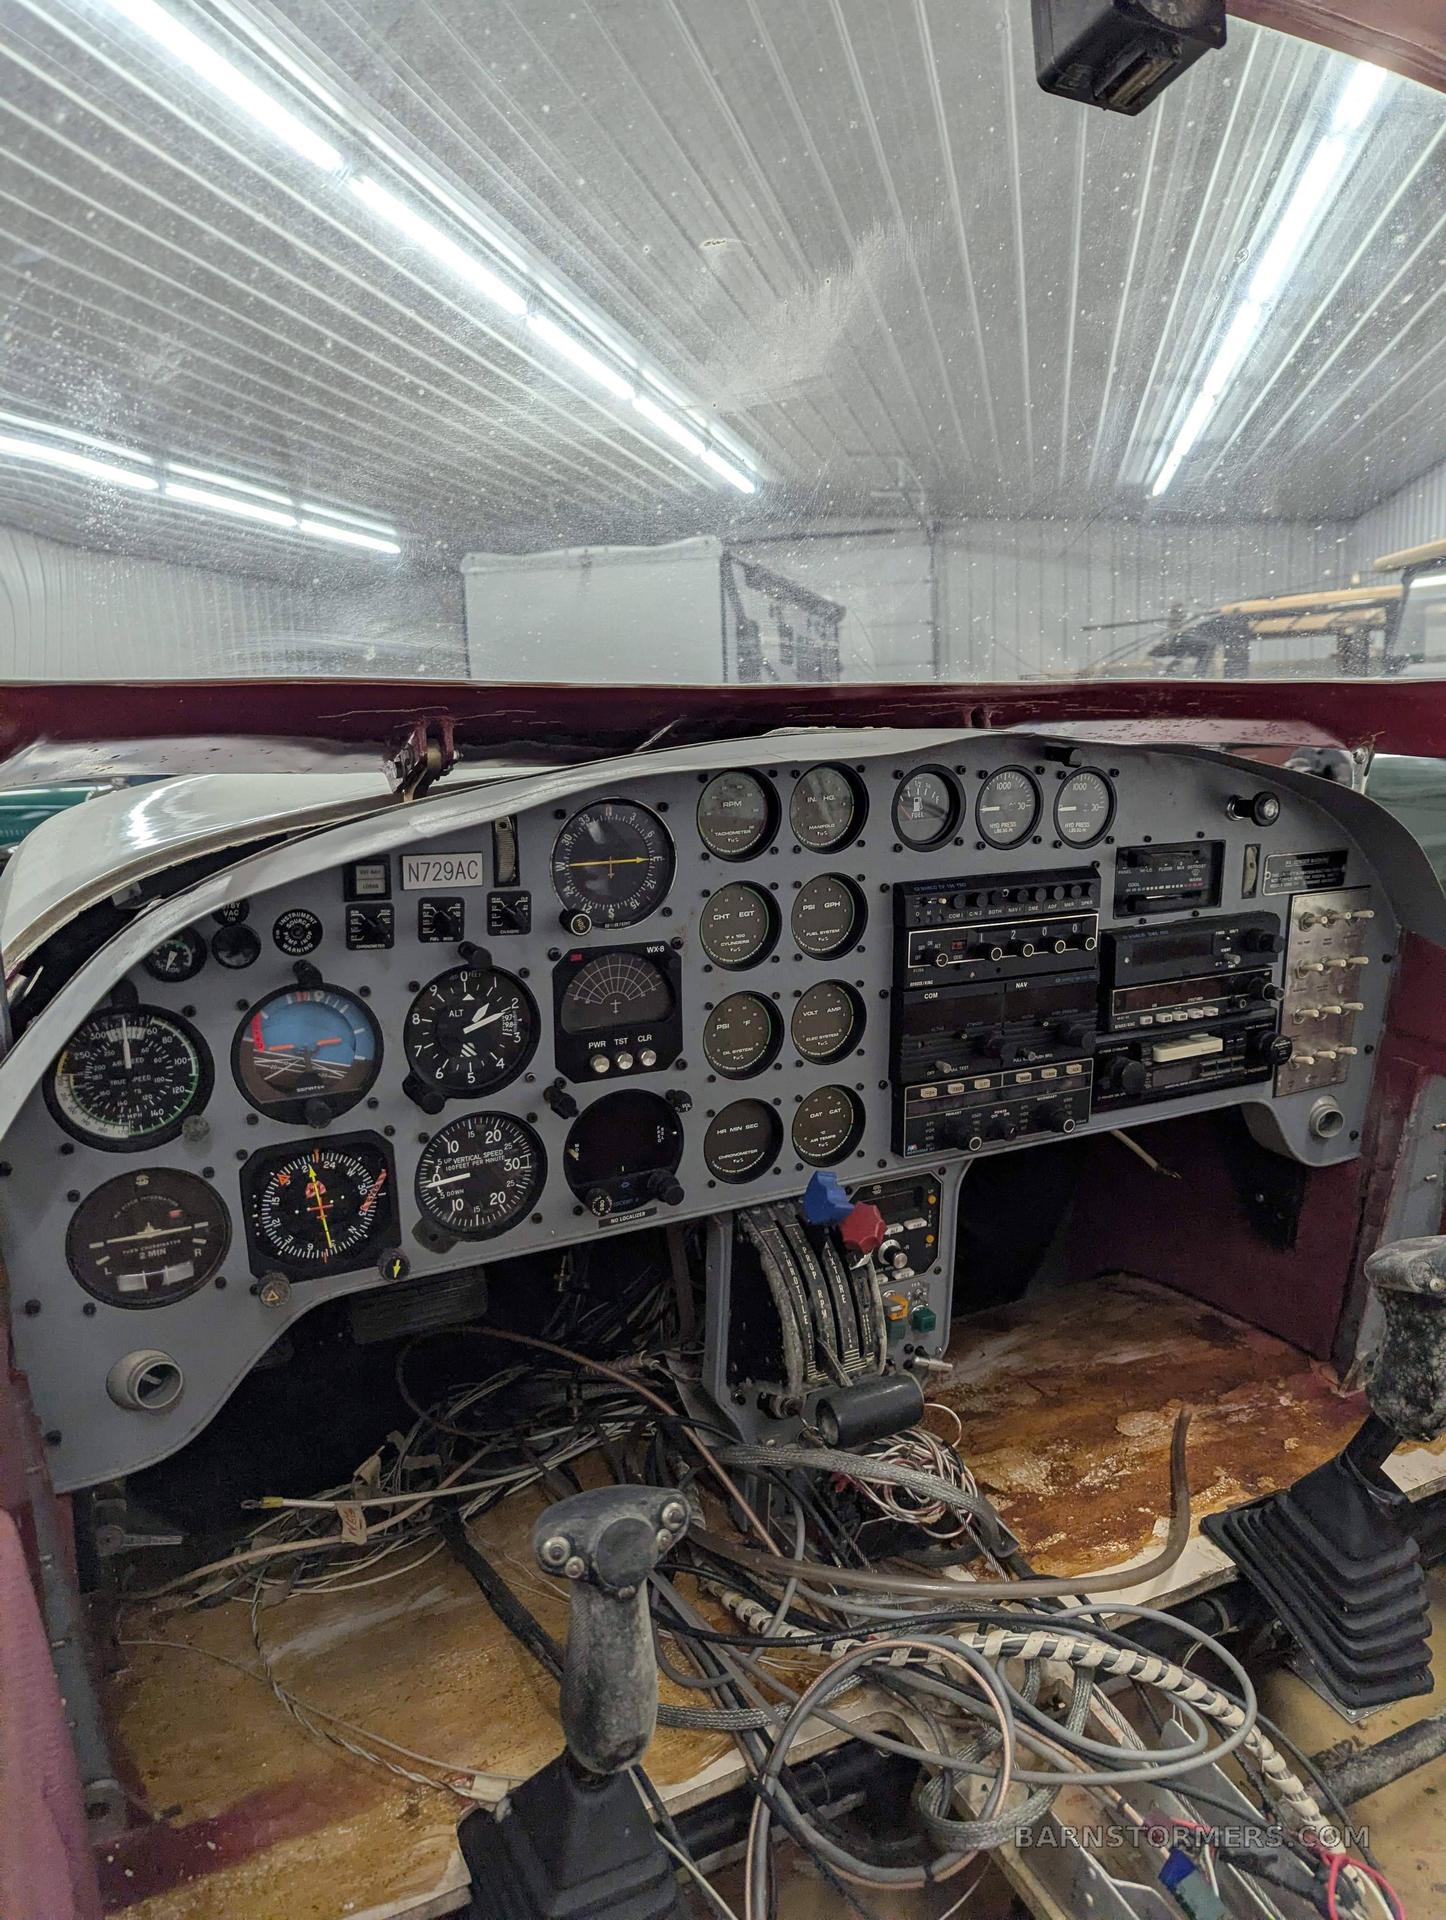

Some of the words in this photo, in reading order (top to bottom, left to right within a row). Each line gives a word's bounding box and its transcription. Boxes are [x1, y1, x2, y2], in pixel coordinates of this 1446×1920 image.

[722, 800, 742, 808] RPM
[715, 829, 751, 837] TACHOMETER
[561, 833, 573, 846] 30
[408, 860, 479, 883] N729AC
[555, 861, 566, 872] W
[823, 901, 841, 909] GPH
[279, 912, 317, 926] INSTRUMENT
[608, 908, 615, 919] S
[713, 913, 731, 921] CHT
[738, 910, 755, 918] EGT
[286, 919, 310, 928] SOURCE
[1011, 930, 1017, 940] 2
[1042, 926, 1048, 937] 0
[1072, 923, 1078, 933] 0
[283, 931, 299, 946] PUMP
[300, 930, 313, 946] INOP
[282, 943, 314, 953] WARNING
[646, 945, 665, 954] WX-8
[460, 970, 468, 982] 0
[429, 984, 438, 997] 9
[511, 997, 519, 1009] 2
[448, 1009, 464, 1018] ALT
[803, 1009, 818, 1017] VOLT
[412, 1013, 421, 1025] 8
[162, 1036, 173, 1044] 80
[513, 1031, 521, 1043] 3
[588, 1040, 606, 1049] PWR
[614, 1037, 629, 1045] TST
[637, 1034, 652, 1043] CLR
[414, 1044, 423, 1057] 7
[174, 1057, 188, 1065] 100
[496, 1058, 505, 1069] 4
[435, 1067, 444, 1079] 6
[467, 1072, 476, 1084] 5
[172, 1086, 185, 1094] 120
[151, 1109, 164, 1118] 140
[809, 1111, 823, 1119] OAT
[468, 1130, 475, 1139] 15
[485, 1129, 502, 1144] 20
[447, 1140, 459, 1154] 10
[504, 1142, 513, 1150] 25
[453, 1154, 482, 1164] VERTICAL
[482, 1149, 504, 1158] SPEED
[485, 1155, 505, 1164] MINUTE
[718, 1149, 758, 1160] CHRONOMETER
[323, 1161, 336, 1170] 24
[504, 1157, 520, 1171] 30
[357, 1183, 368, 1196] 30
[506, 1180, 515, 1188] 25
[446, 1188, 465, 1197] DOWN
[490, 1191, 506, 1206] 20
[452, 1198, 464, 1211] 10
[619, 1211, 646, 1223] LOCALIZER
[148, 1247, 166, 1257] MIN
[194, 1248, 202, 1257] R
[104, 1267, 112, 1275] L
[783, 1251, 809, 1325] THROTTLE
[802, 1246, 817, 1280] PROP
[817, 1289, 828, 1320] RPM
